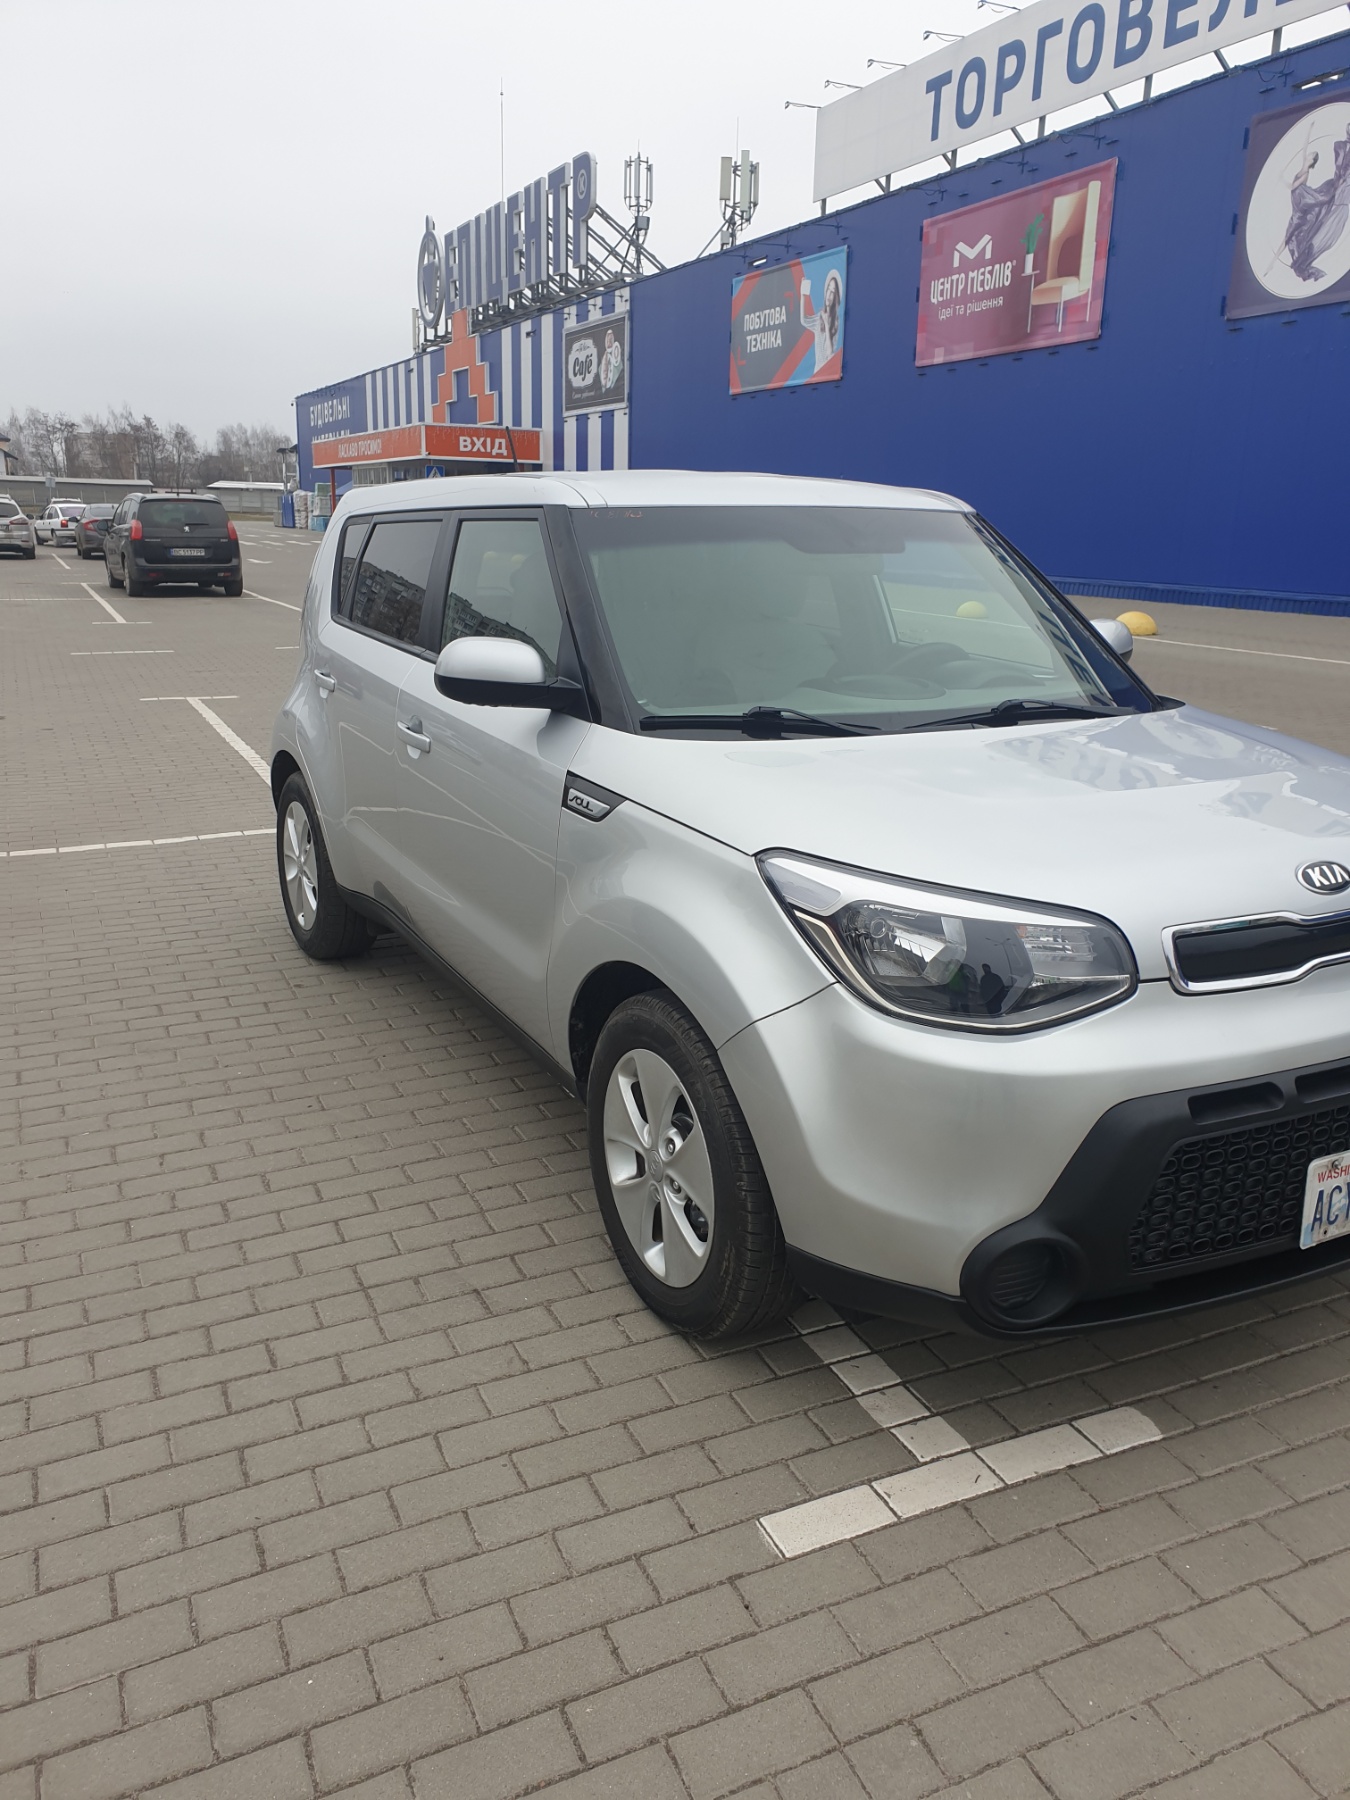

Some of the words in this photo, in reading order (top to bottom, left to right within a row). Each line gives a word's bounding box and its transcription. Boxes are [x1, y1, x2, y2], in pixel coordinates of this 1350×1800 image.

[926, 0, 1291, 141] ТОРГОВЕ
[444, 151, 597, 318] ЕПІЦЕНТР
[930, 273, 966, 305] ЦЕНТР
[744, 305, 787, 332] ПОБУТОВА
[938, 305, 954, 320] ідеї
[956, 304, 964, 315] та
[966, 296, 1003, 316] рішення
[746, 329, 782, 353] ТЕХНІКА
[573, 353, 593, 382] Café
[309, 395, 350, 429] БУДІВЕЛЬНІ
[459, 436, 508, 456] ВХІД
[1305, 864, 1350, 887] KIA
[1318, 1164, 1350, 1183] WASHI
